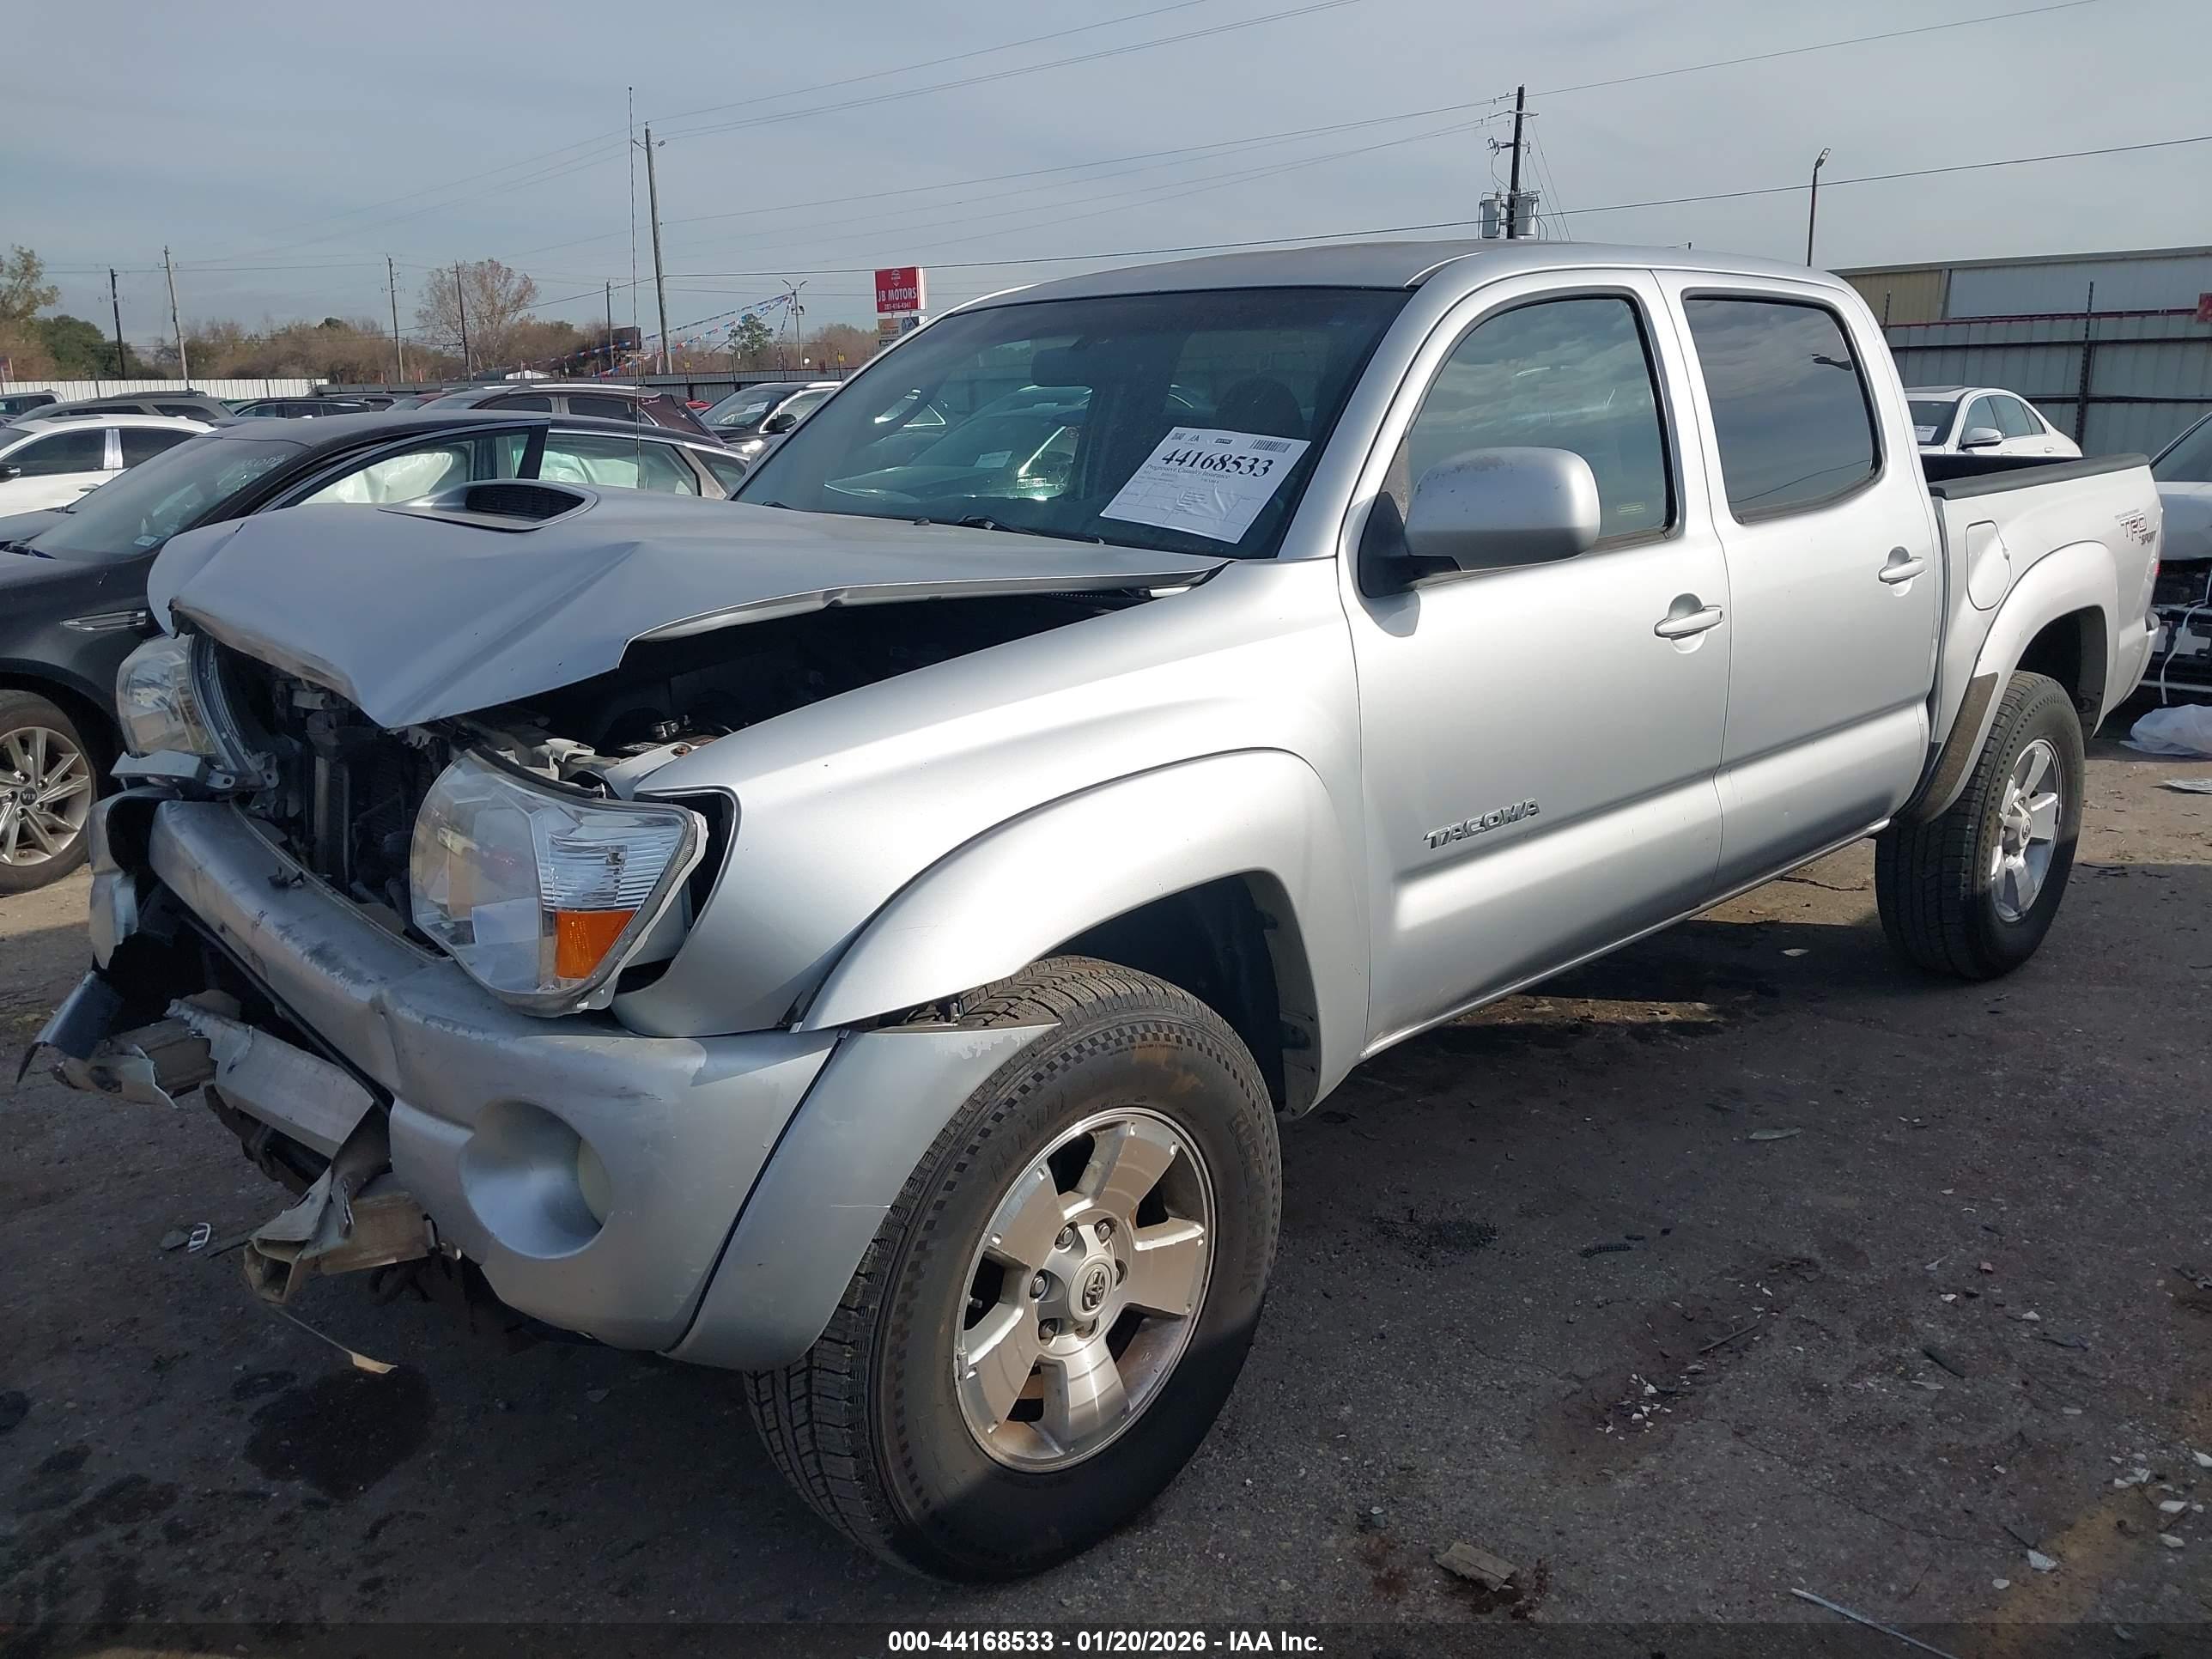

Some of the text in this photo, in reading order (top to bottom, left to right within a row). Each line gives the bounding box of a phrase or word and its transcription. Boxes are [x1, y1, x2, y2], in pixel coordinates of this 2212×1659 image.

[878, 287, 917, 302] JB MOTORS
[1162, 448, 1274, 477] 44168533
[2118, 513, 2148, 542] TRD
[1423, 797, 1540, 850] TACOMA
